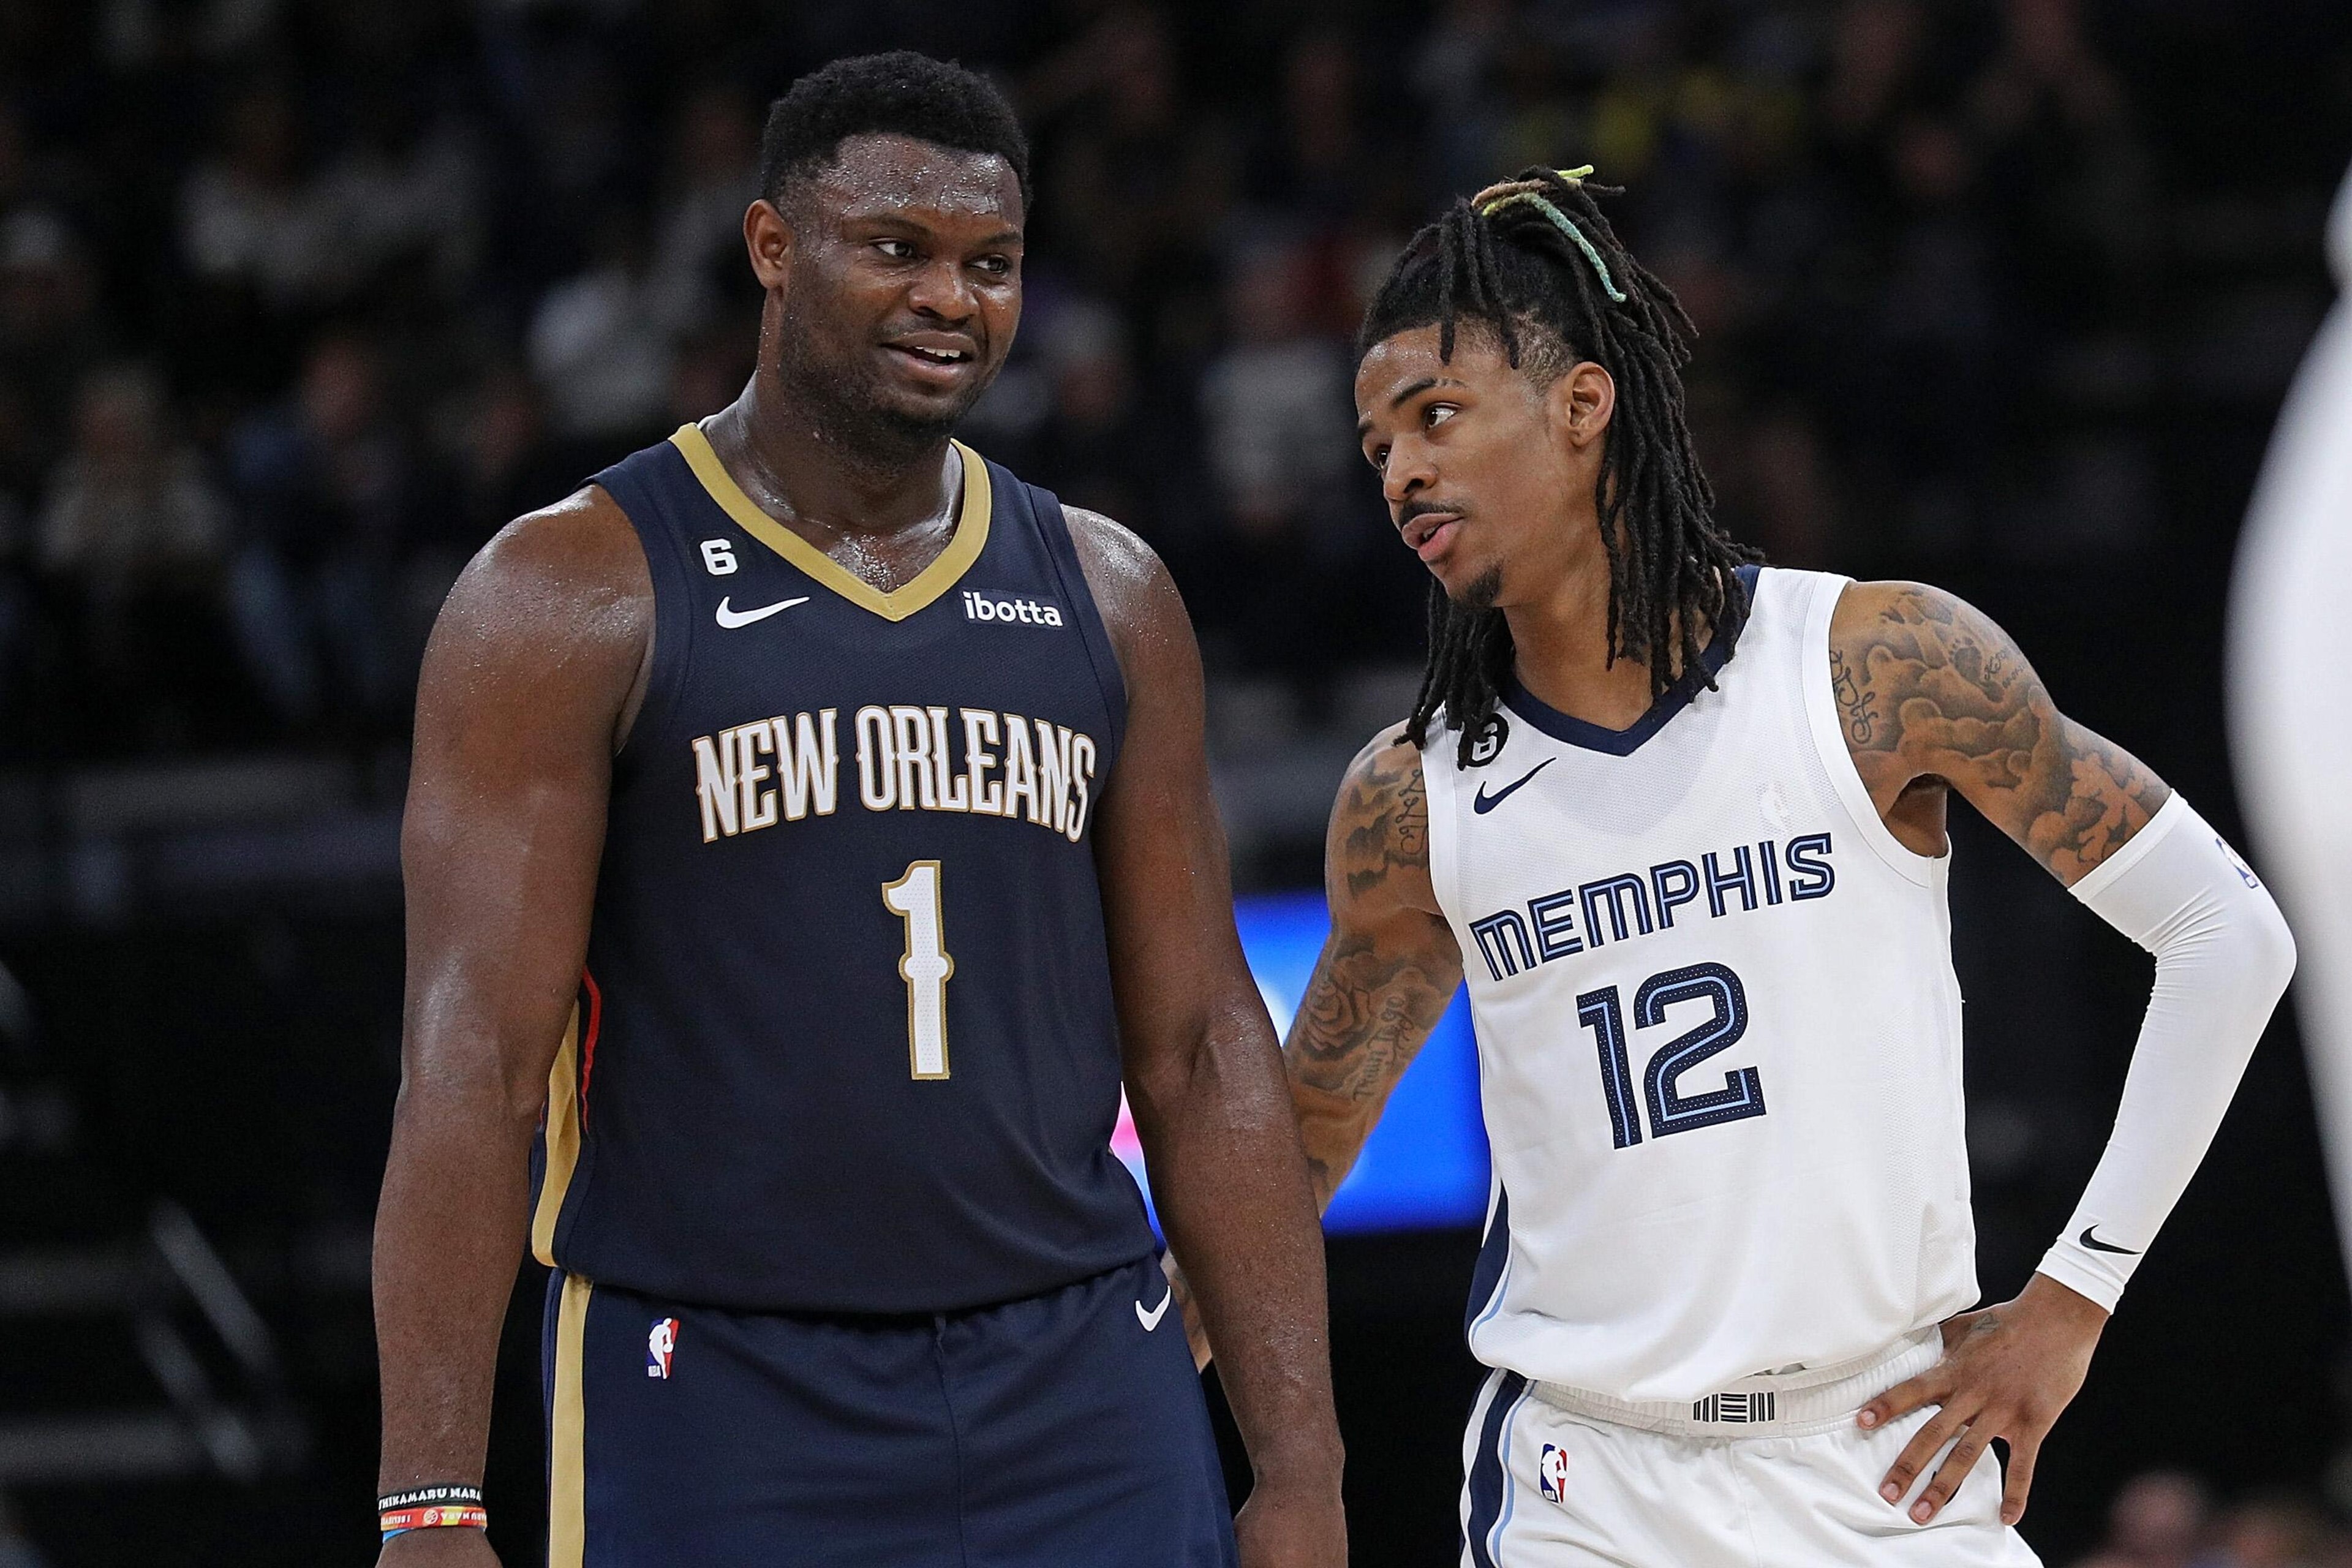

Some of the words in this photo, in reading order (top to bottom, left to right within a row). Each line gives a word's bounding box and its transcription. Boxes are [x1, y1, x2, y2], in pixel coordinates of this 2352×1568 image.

[701, 538, 738, 576] 6
[963, 592, 1063, 627] ibotta
[692, 709, 839, 843] NEW
[855, 705, 1095, 843] ORLEANS
[881, 860, 955, 1080] 1
[1469, 832, 1836, 982] MEMPHIS
[1576, 962, 1766, 1150] 12
[450, 1488, 481, 1501] NARA
